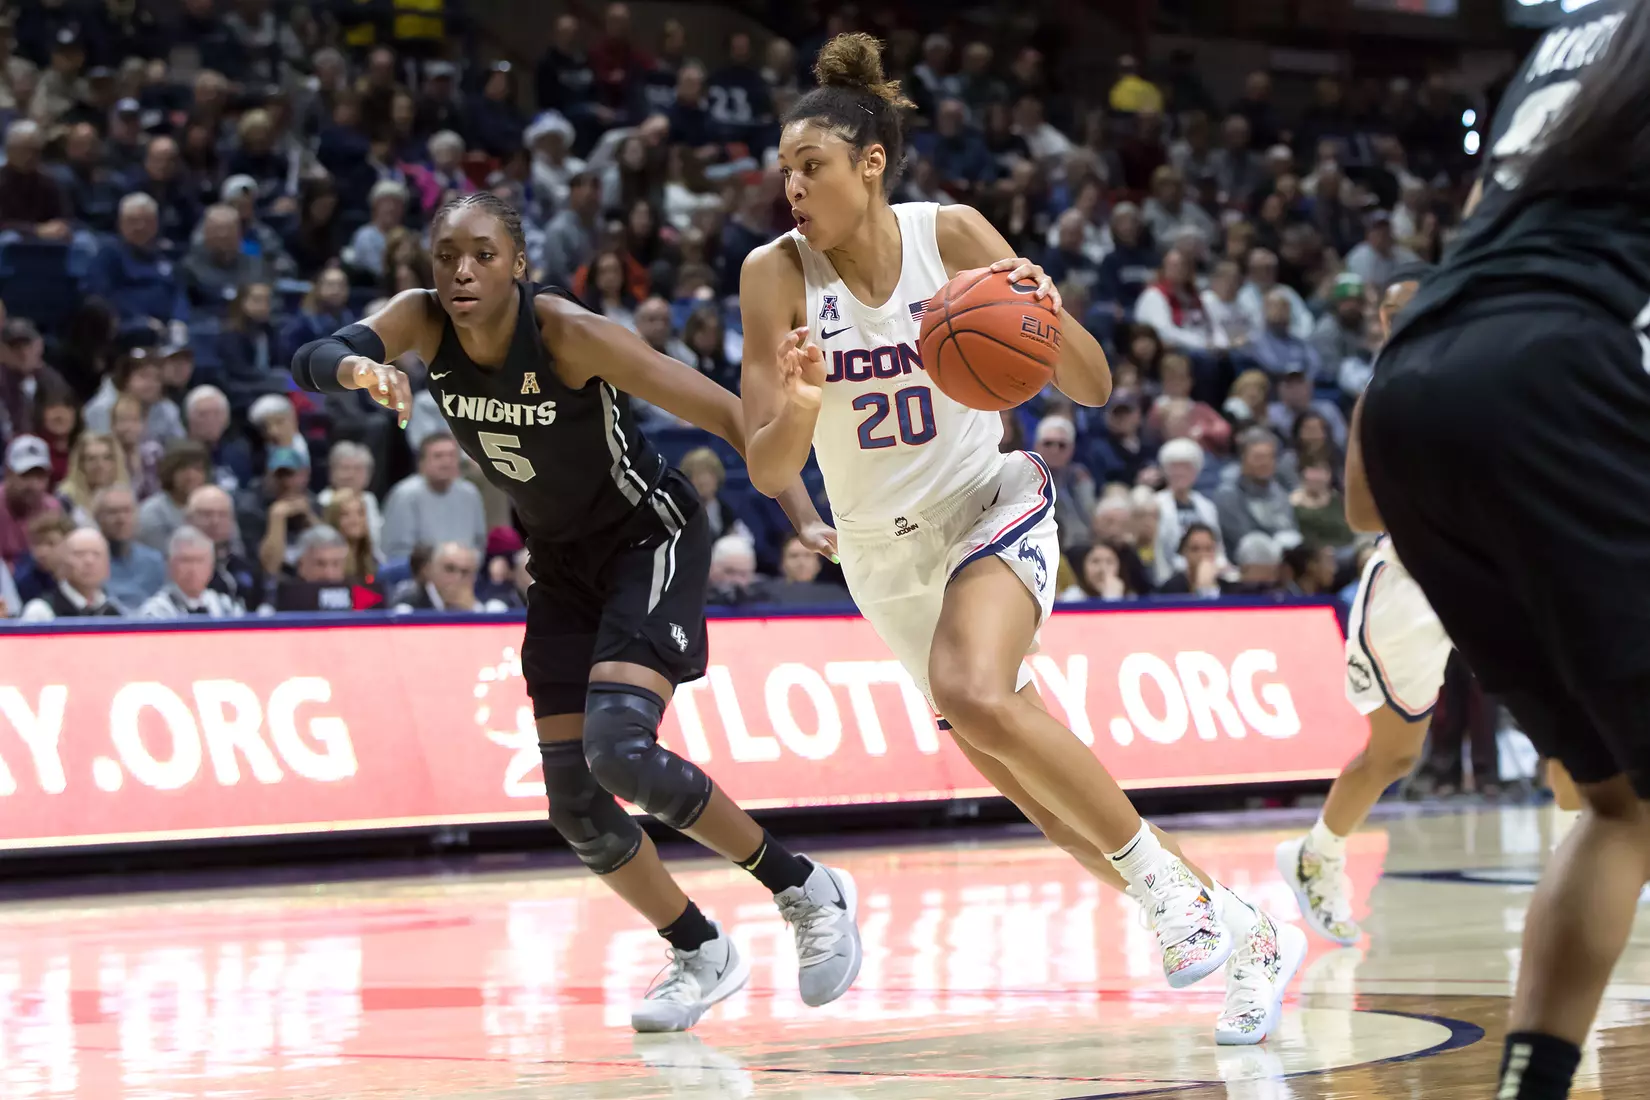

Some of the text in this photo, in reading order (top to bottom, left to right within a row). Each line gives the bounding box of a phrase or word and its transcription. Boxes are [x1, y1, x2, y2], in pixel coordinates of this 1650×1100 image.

[822, 339, 926, 383] UCON
[440, 388, 557, 426] KNIGHTS
[851, 385, 938, 450] 20
[477, 430, 537, 483] 5
[0, 676, 358, 796] Y.ORG
